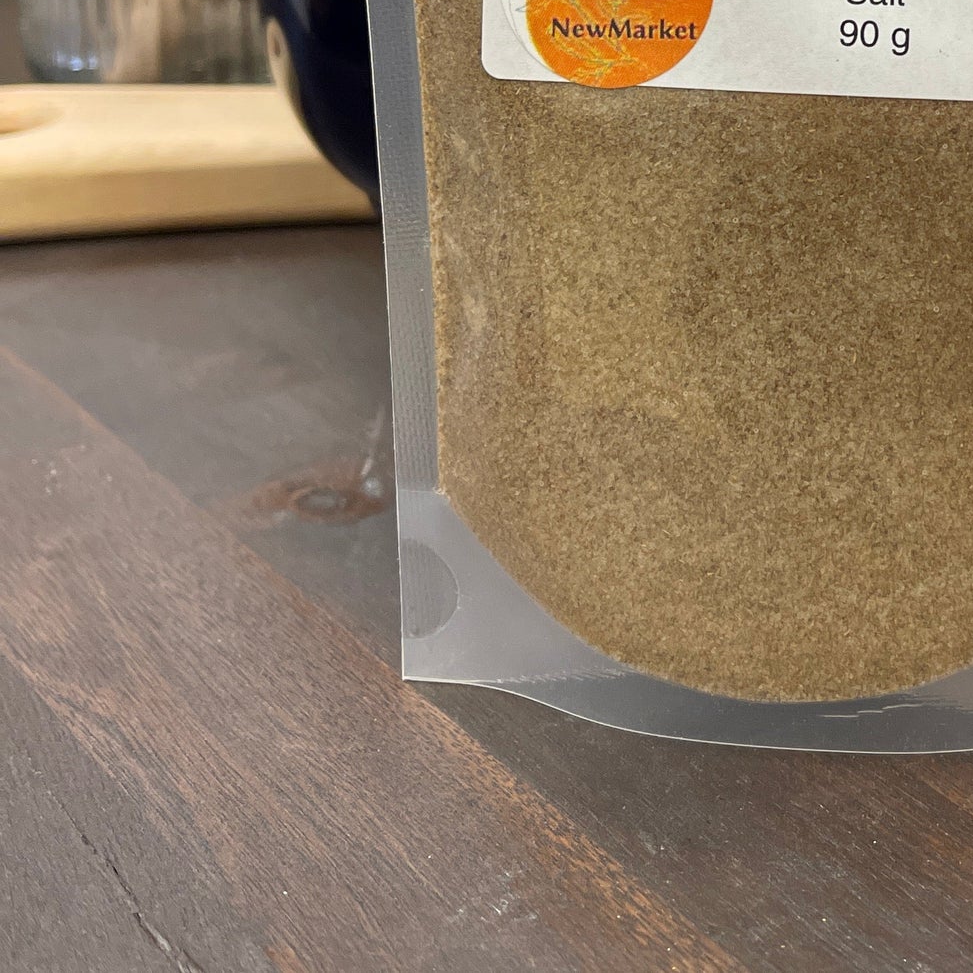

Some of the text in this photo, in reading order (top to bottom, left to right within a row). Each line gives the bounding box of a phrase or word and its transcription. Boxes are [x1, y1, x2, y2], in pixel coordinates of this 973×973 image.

[550, 16, 698, 41] NewMarket
[838, 20, 911, 56] 90 g
